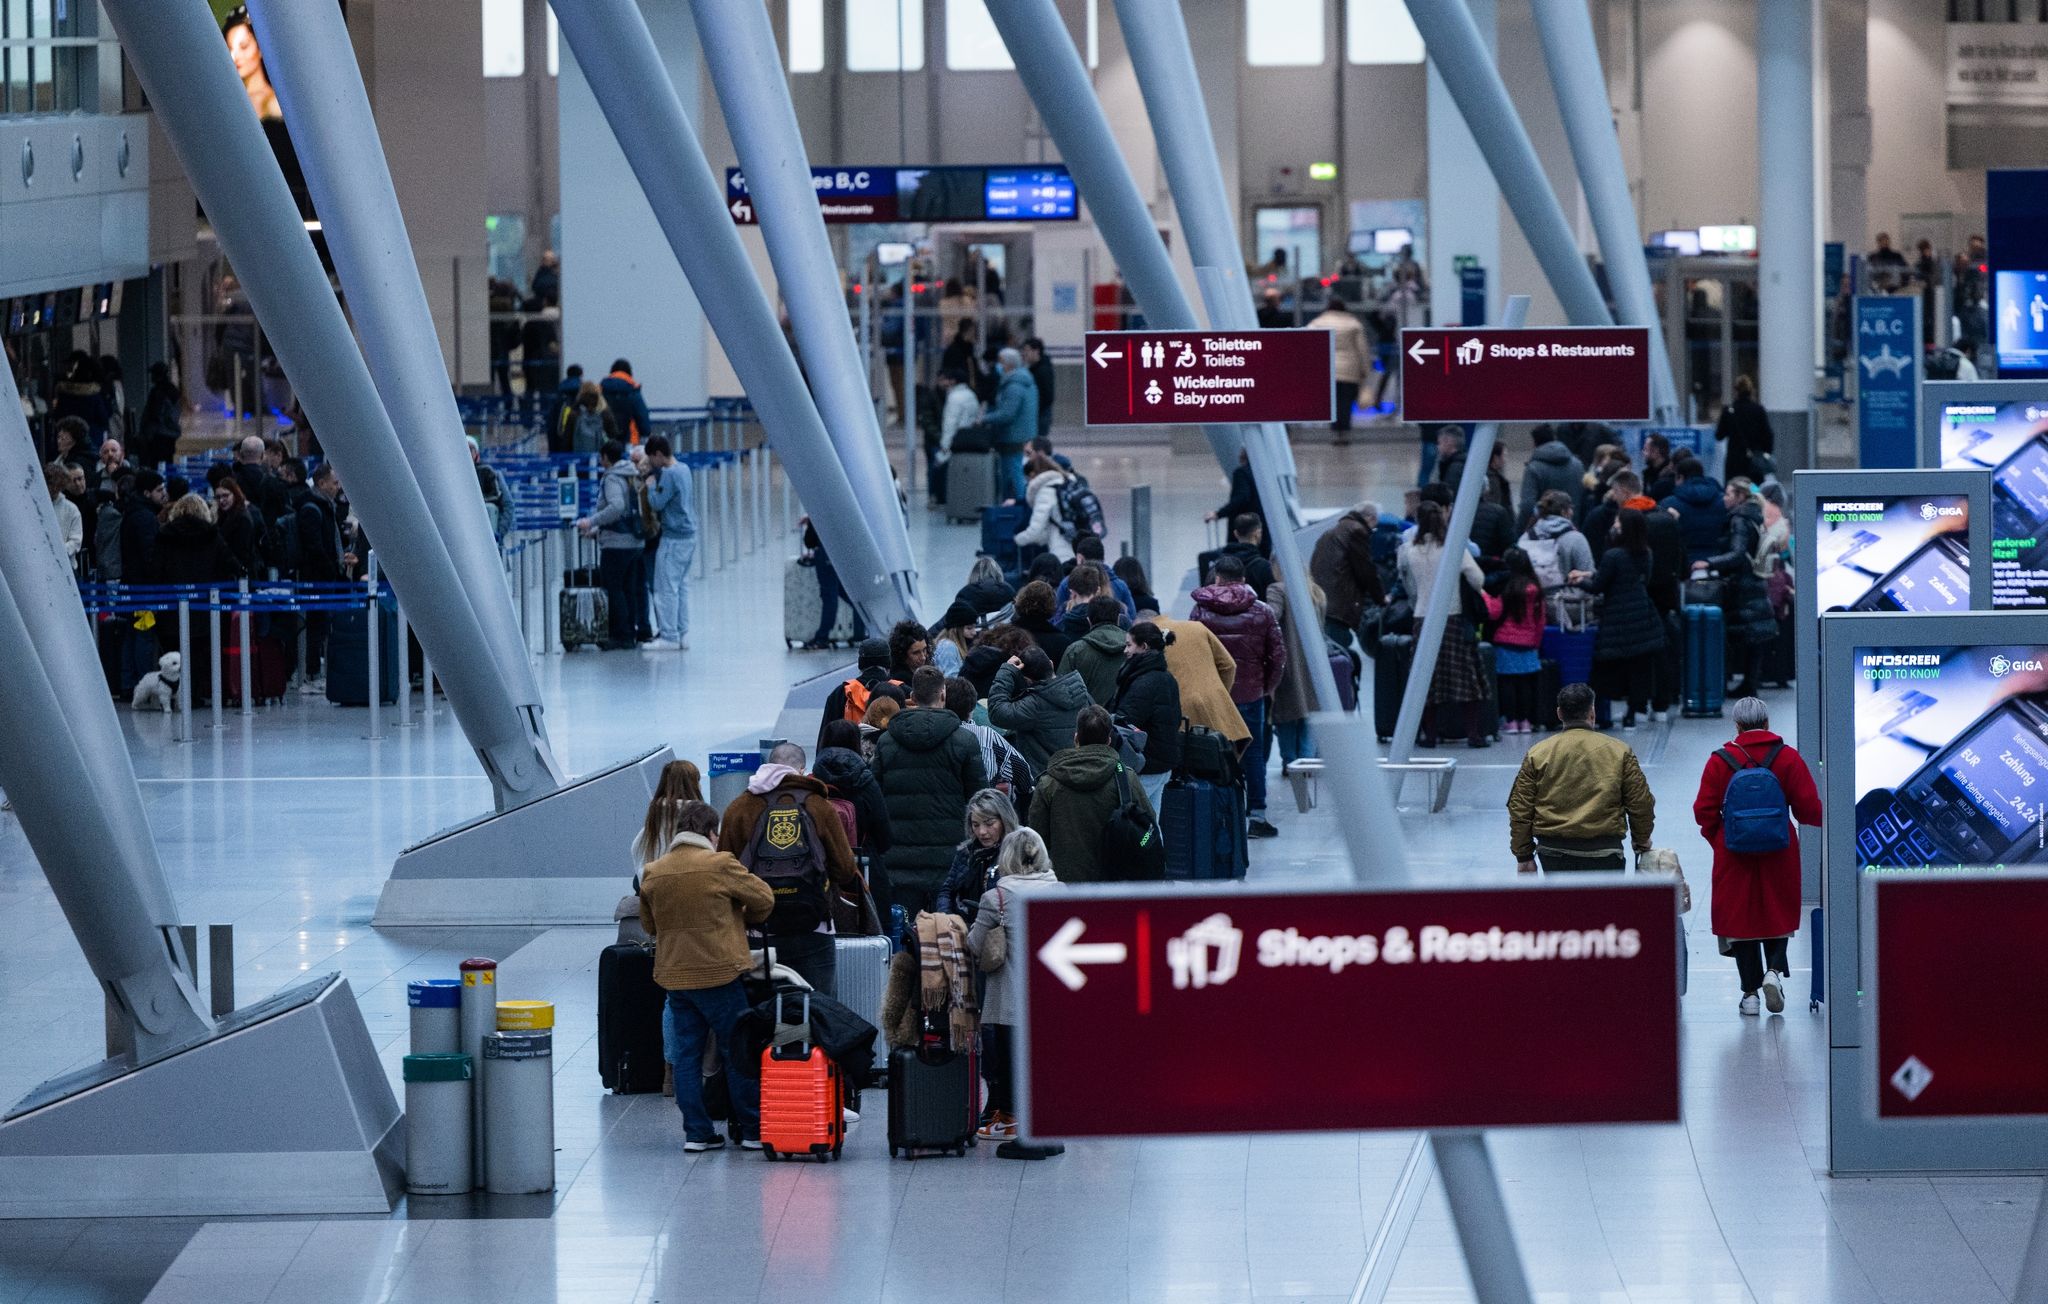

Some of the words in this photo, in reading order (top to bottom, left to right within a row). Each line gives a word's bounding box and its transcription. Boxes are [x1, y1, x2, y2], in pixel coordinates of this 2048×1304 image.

[1169, 340, 1183, 348] WC
[1202, 338, 1262, 351] Toiletten
[1490, 344, 1535, 360] Shops
[1537, 344, 1549, 356] &
[1551, 343, 1635, 357] Restaurants
[1203, 354, 1245, 367] Toilets
[1173, 376, 1255, 389] Wickelraum
[1174, 392, 1207, 408] Baby
[1210, 393, 1245, 404] room
[1823, 503, 1884, 511] INFOSCREEN
[1938, 509, 1963, 517] GIGA
[1824, 514, 1845, 522] GOOD
[1848, 514, 1858, 522] TO
[1860, 514, 1883, 522] KNOW
[1993, 549, 2018, 560] lizei!
[1863, 655, 1940, 666] INFOSCREEN
[2012, 661, 2043, 672] GIGA
[1864, 669, 1891, 680] GOOD
[1895, 669, 1907, 679] TO
[1910, 668, 1940, 679] KNOW
[1960, 748, 1981, 767] EUR
[1999, 750, 2036, 787] Zahlung
[1953, 770, 1968, 785] Bitte
[1966, 782, 1985, 804] Betrag
[1983, 799, 2010, 828] eingeben
[1256, 928, 1379, 975] Shops
[1381, 926, 1415, 964] &
[1419, 923, 1642, 963] Restaurants
